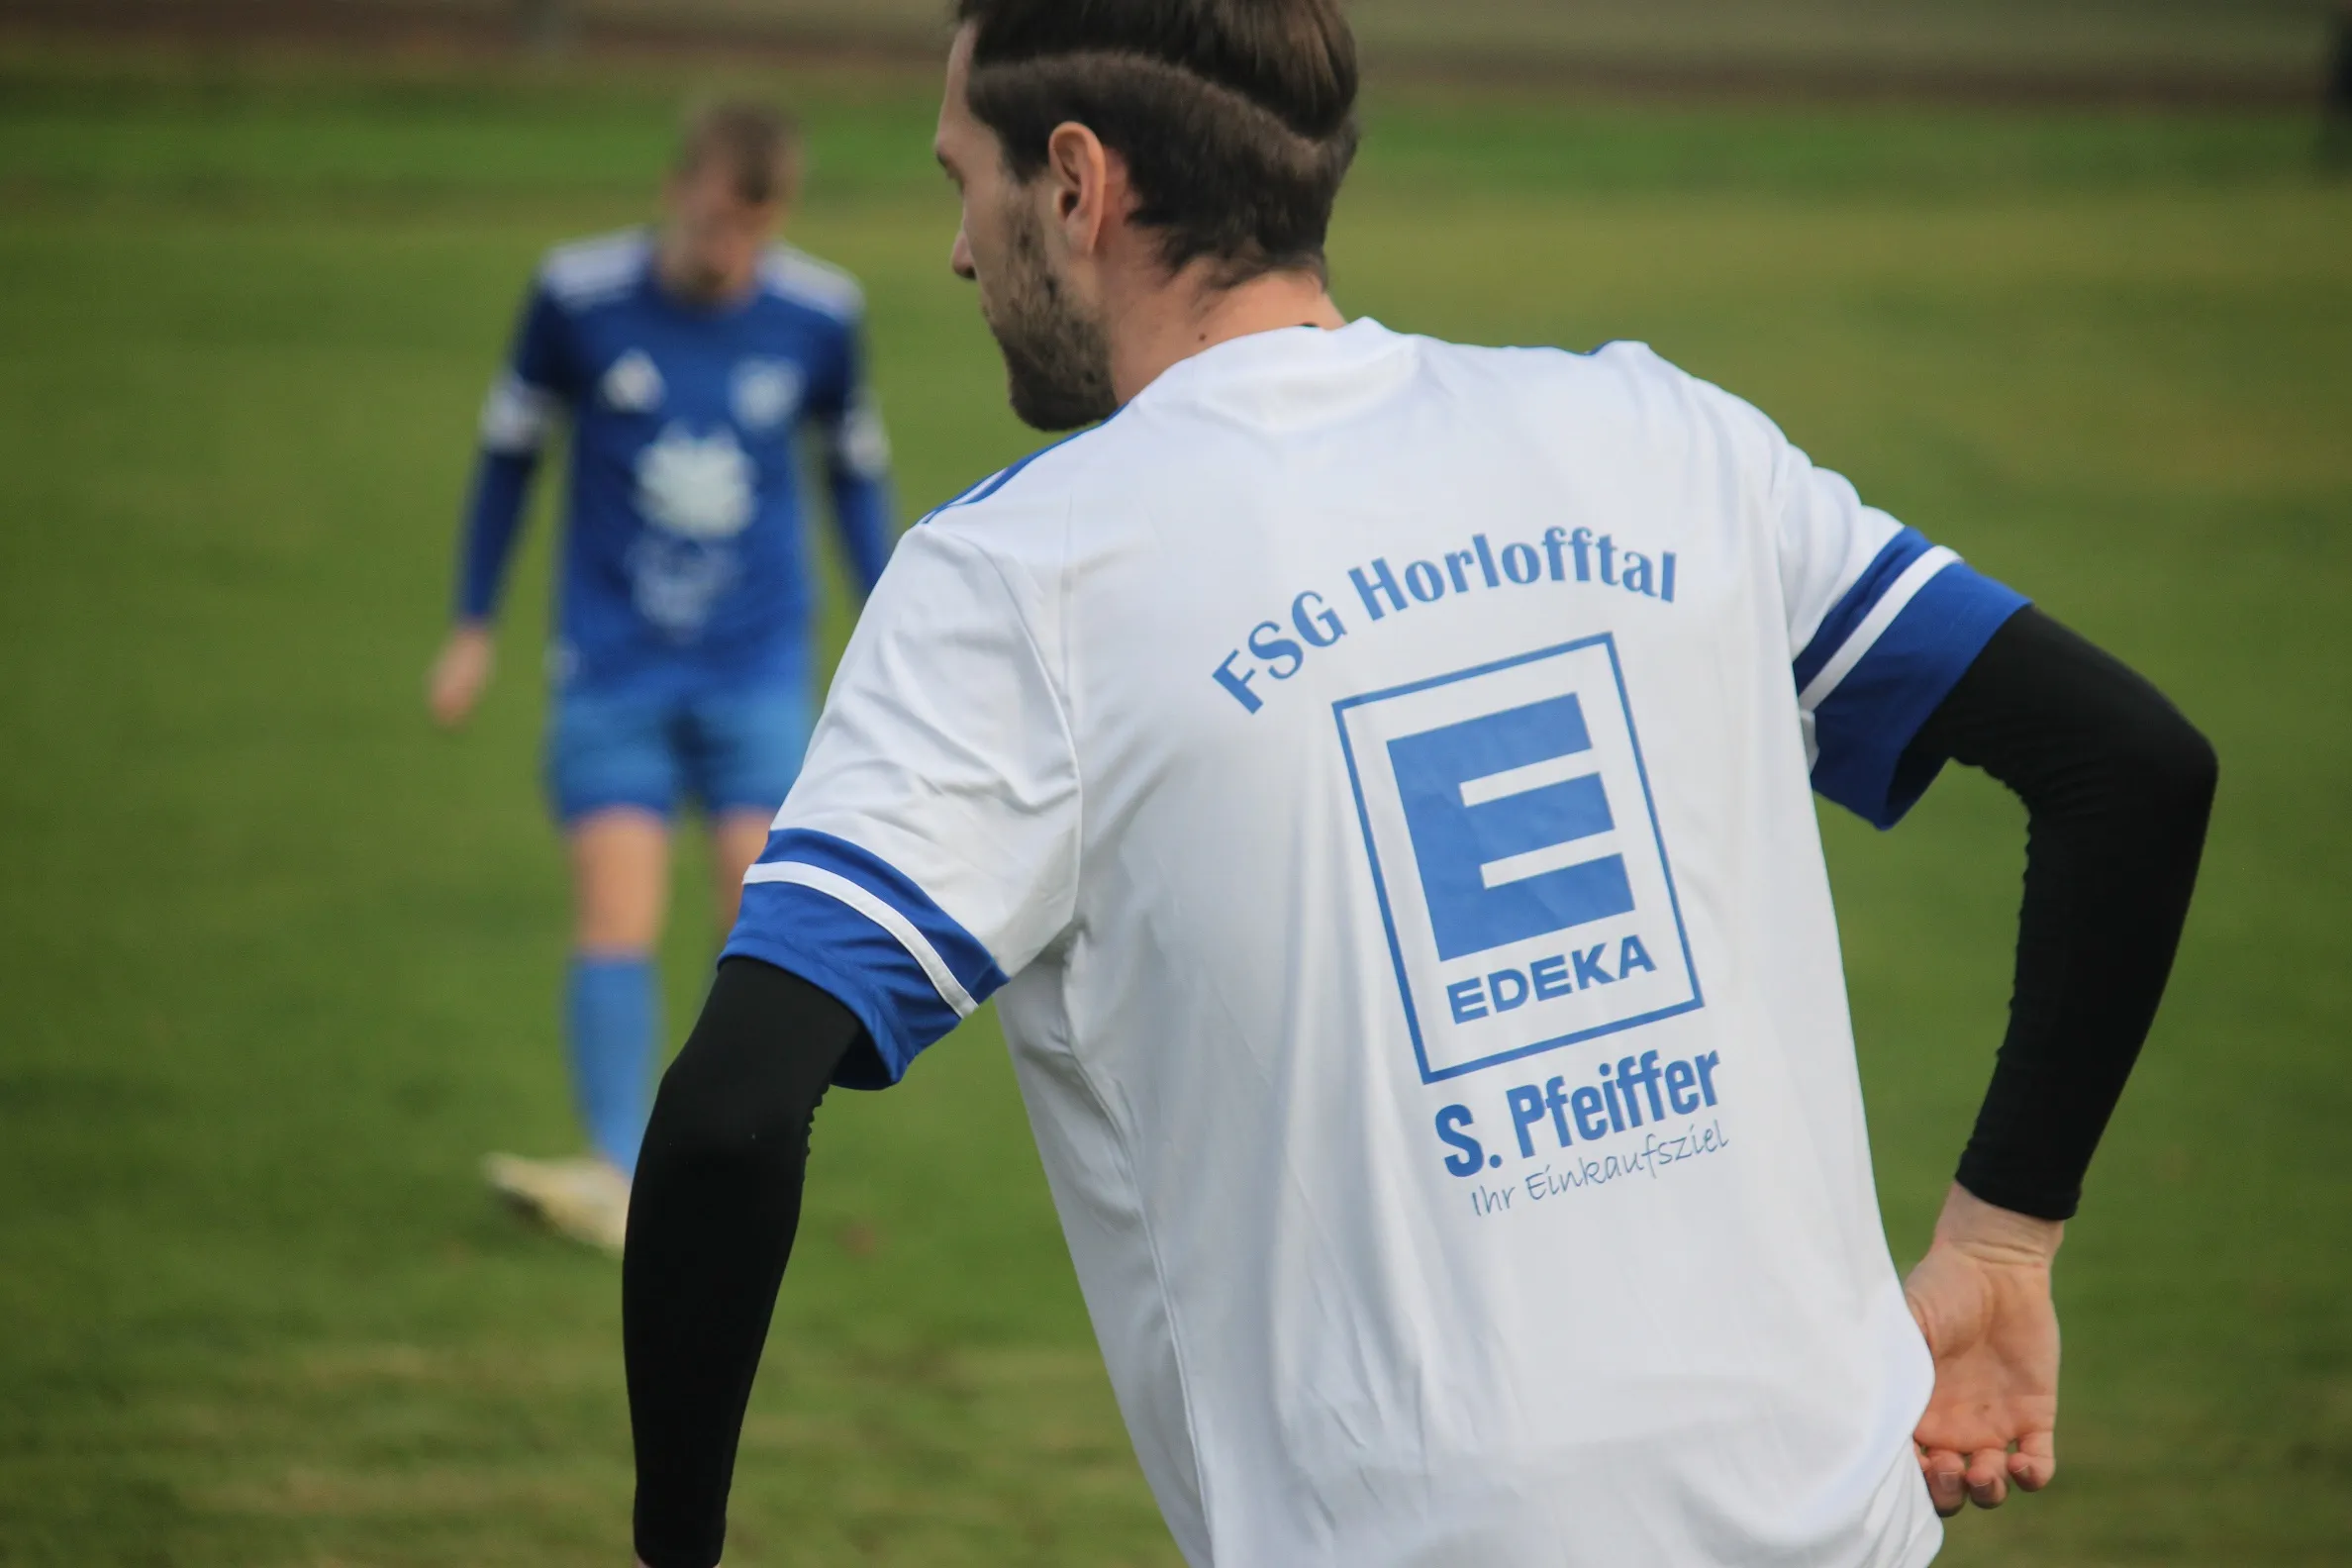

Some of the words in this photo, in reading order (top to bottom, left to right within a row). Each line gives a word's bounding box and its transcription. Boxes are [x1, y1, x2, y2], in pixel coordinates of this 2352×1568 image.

[1211, 590, 1346, 715] FSG
[1347, 526, 1677, 622] Horlofftal
[1386, 692, 1635, 963] E
[1445, 934, 1657, 1026] EDEKA
[1433, 1102, 1503, 1179] S.
[1505, 1048, 1720, 1159] Pfeiffer
[1470, 1184, 1517, 1218] Ihr
[1524, 1119, 1730, 1202] Einkaufsziel
